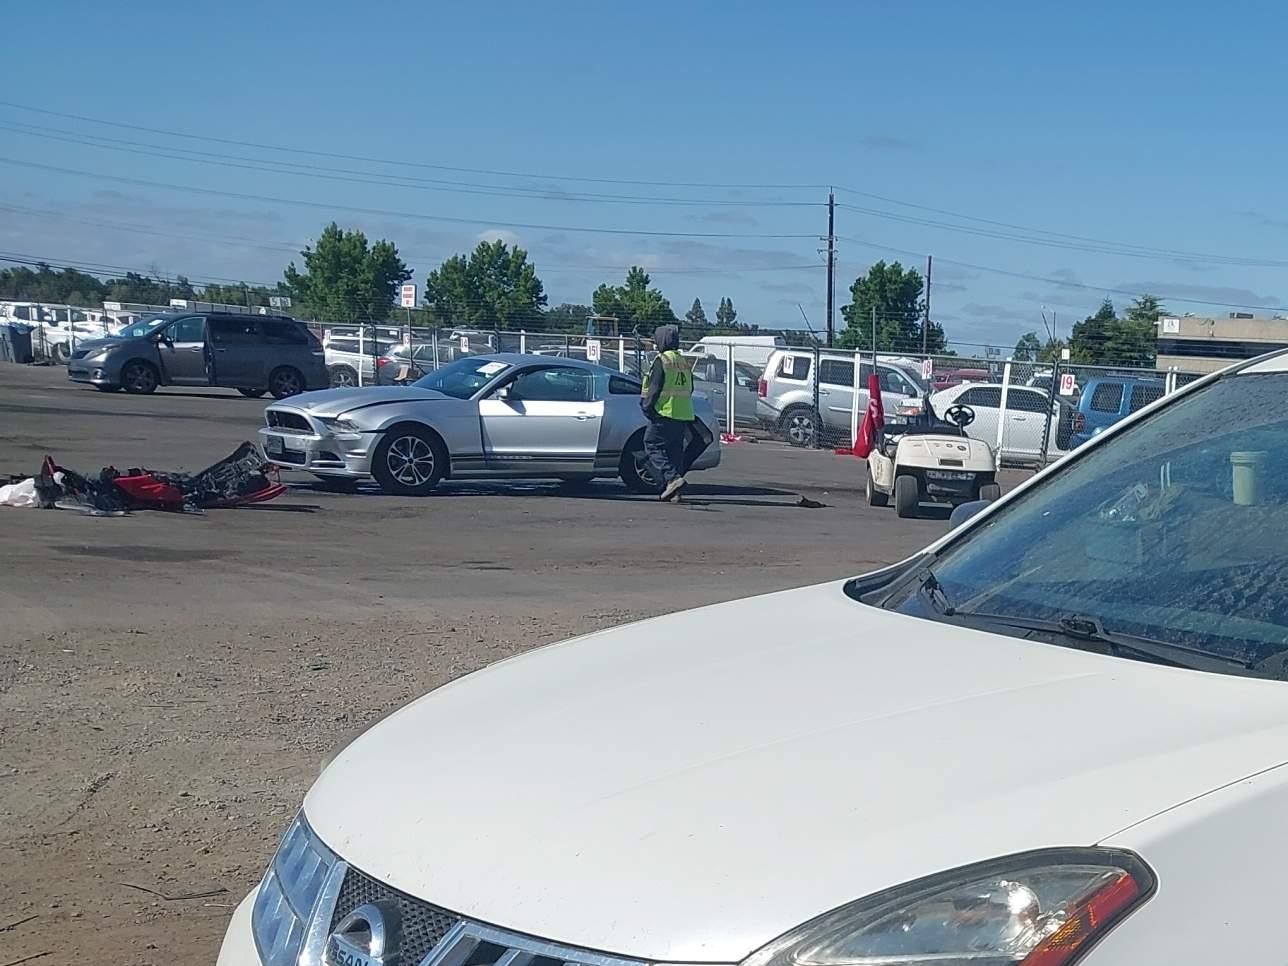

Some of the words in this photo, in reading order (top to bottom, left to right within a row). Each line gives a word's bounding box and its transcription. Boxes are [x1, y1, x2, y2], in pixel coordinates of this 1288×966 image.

[588, 345, 596, 357] 15
[785, 356, 793, 369] 17
[1062, 375, 1073, 390] 19
